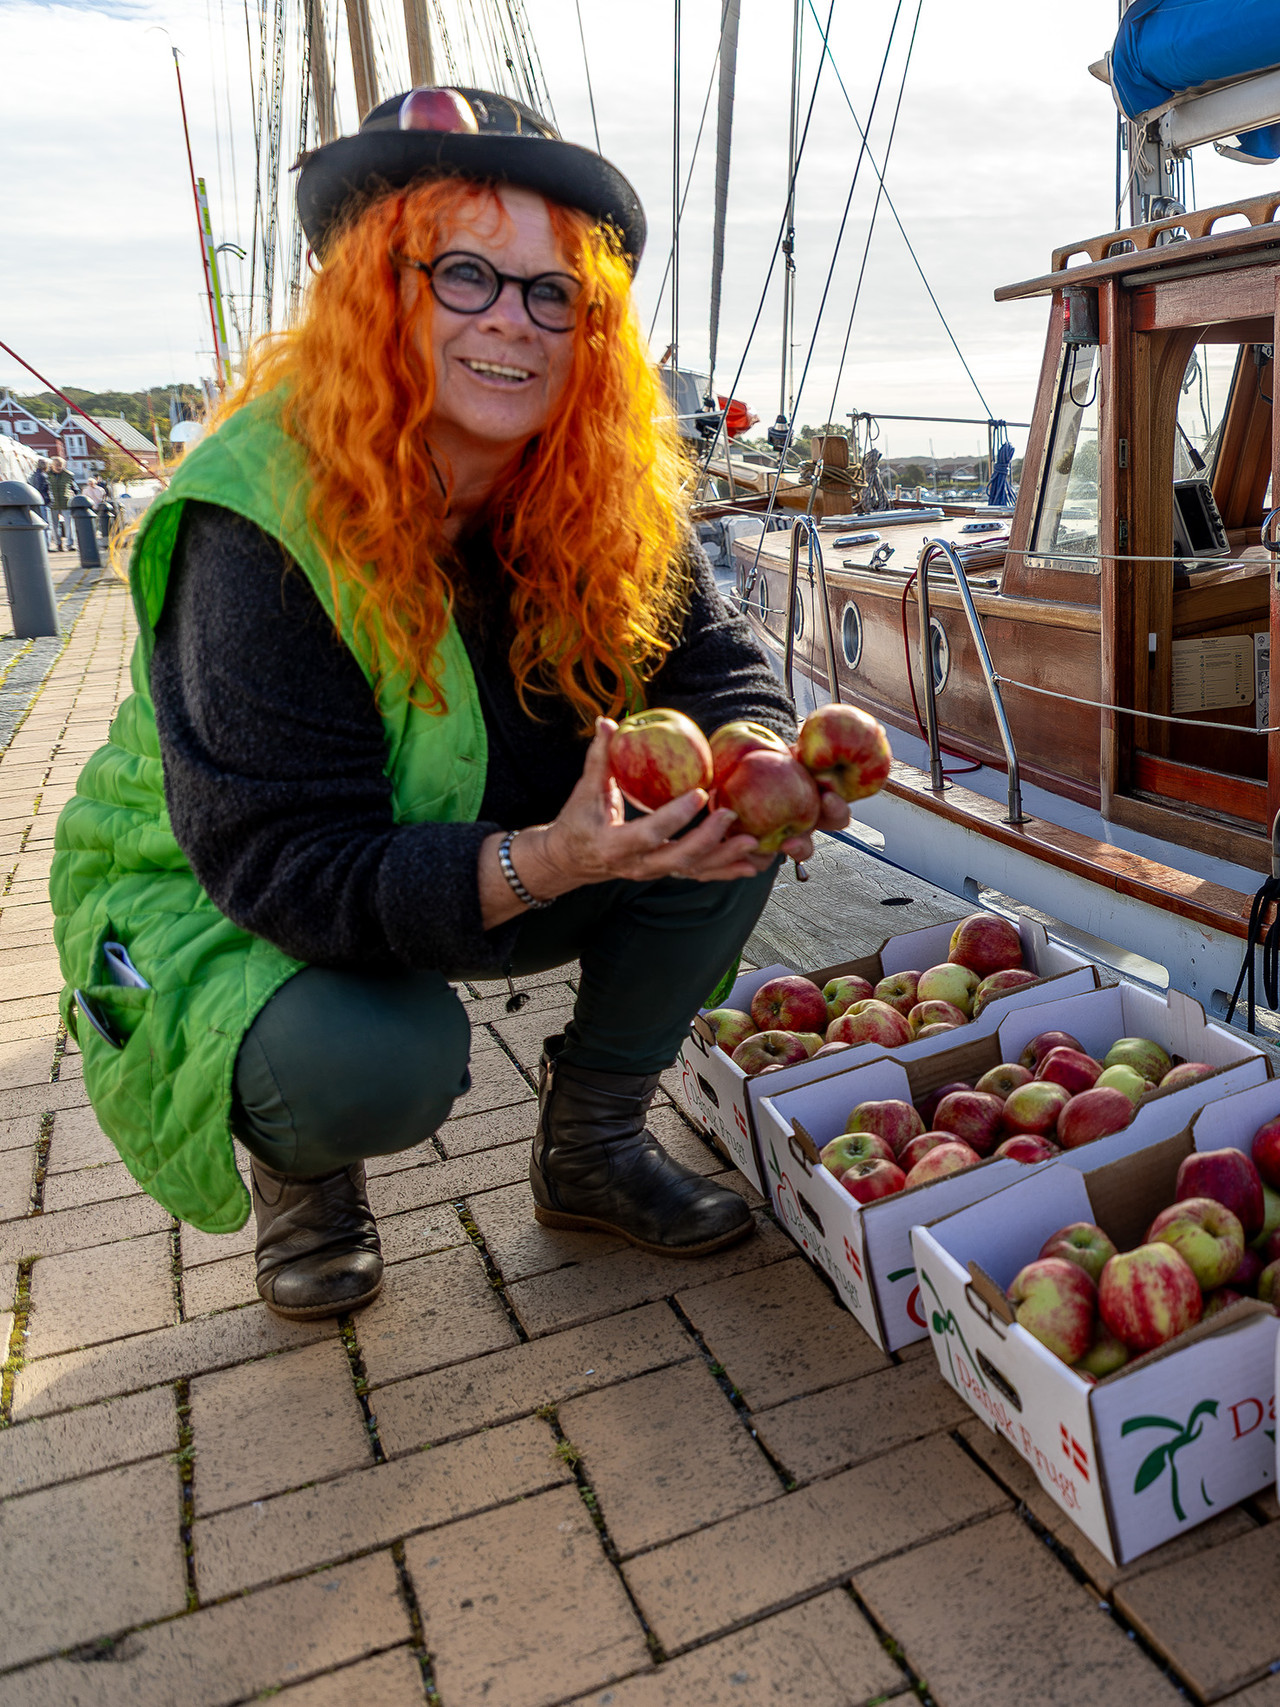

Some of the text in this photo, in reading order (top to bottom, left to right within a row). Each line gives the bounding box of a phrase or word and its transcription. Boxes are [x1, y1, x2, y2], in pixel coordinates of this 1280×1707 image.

[689, 1082, 720, 1131] Dansk
[786, 1197, 861, 1308] Dansk Frugt
[955, 1353, 1081, 1510] Dansk Frugt
